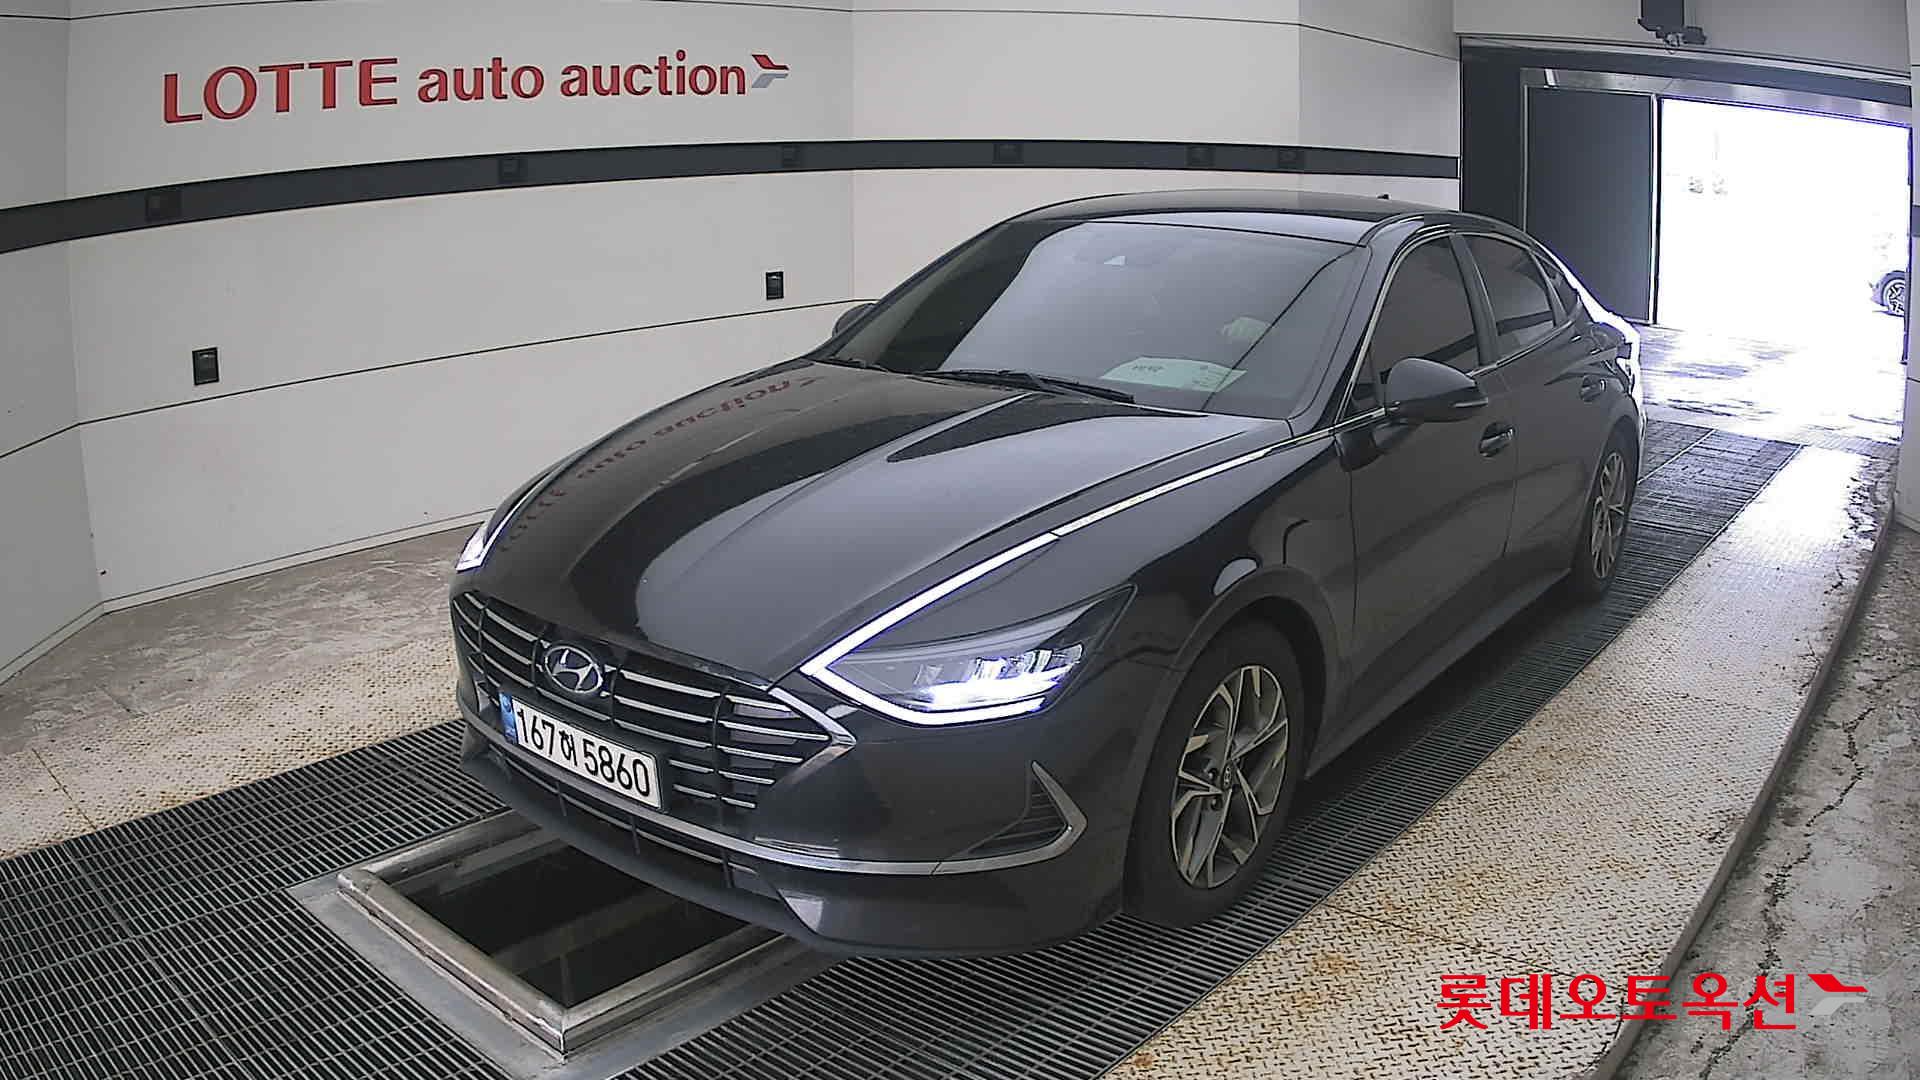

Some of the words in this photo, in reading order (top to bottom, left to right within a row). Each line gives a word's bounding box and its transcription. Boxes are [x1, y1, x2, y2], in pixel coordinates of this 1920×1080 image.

[163, 58, 399, 124] LOTTE
[417, 57, 544, 104] auto
[560, 51, 746, 97] auction
[582, 738, 651, 798] 5860
